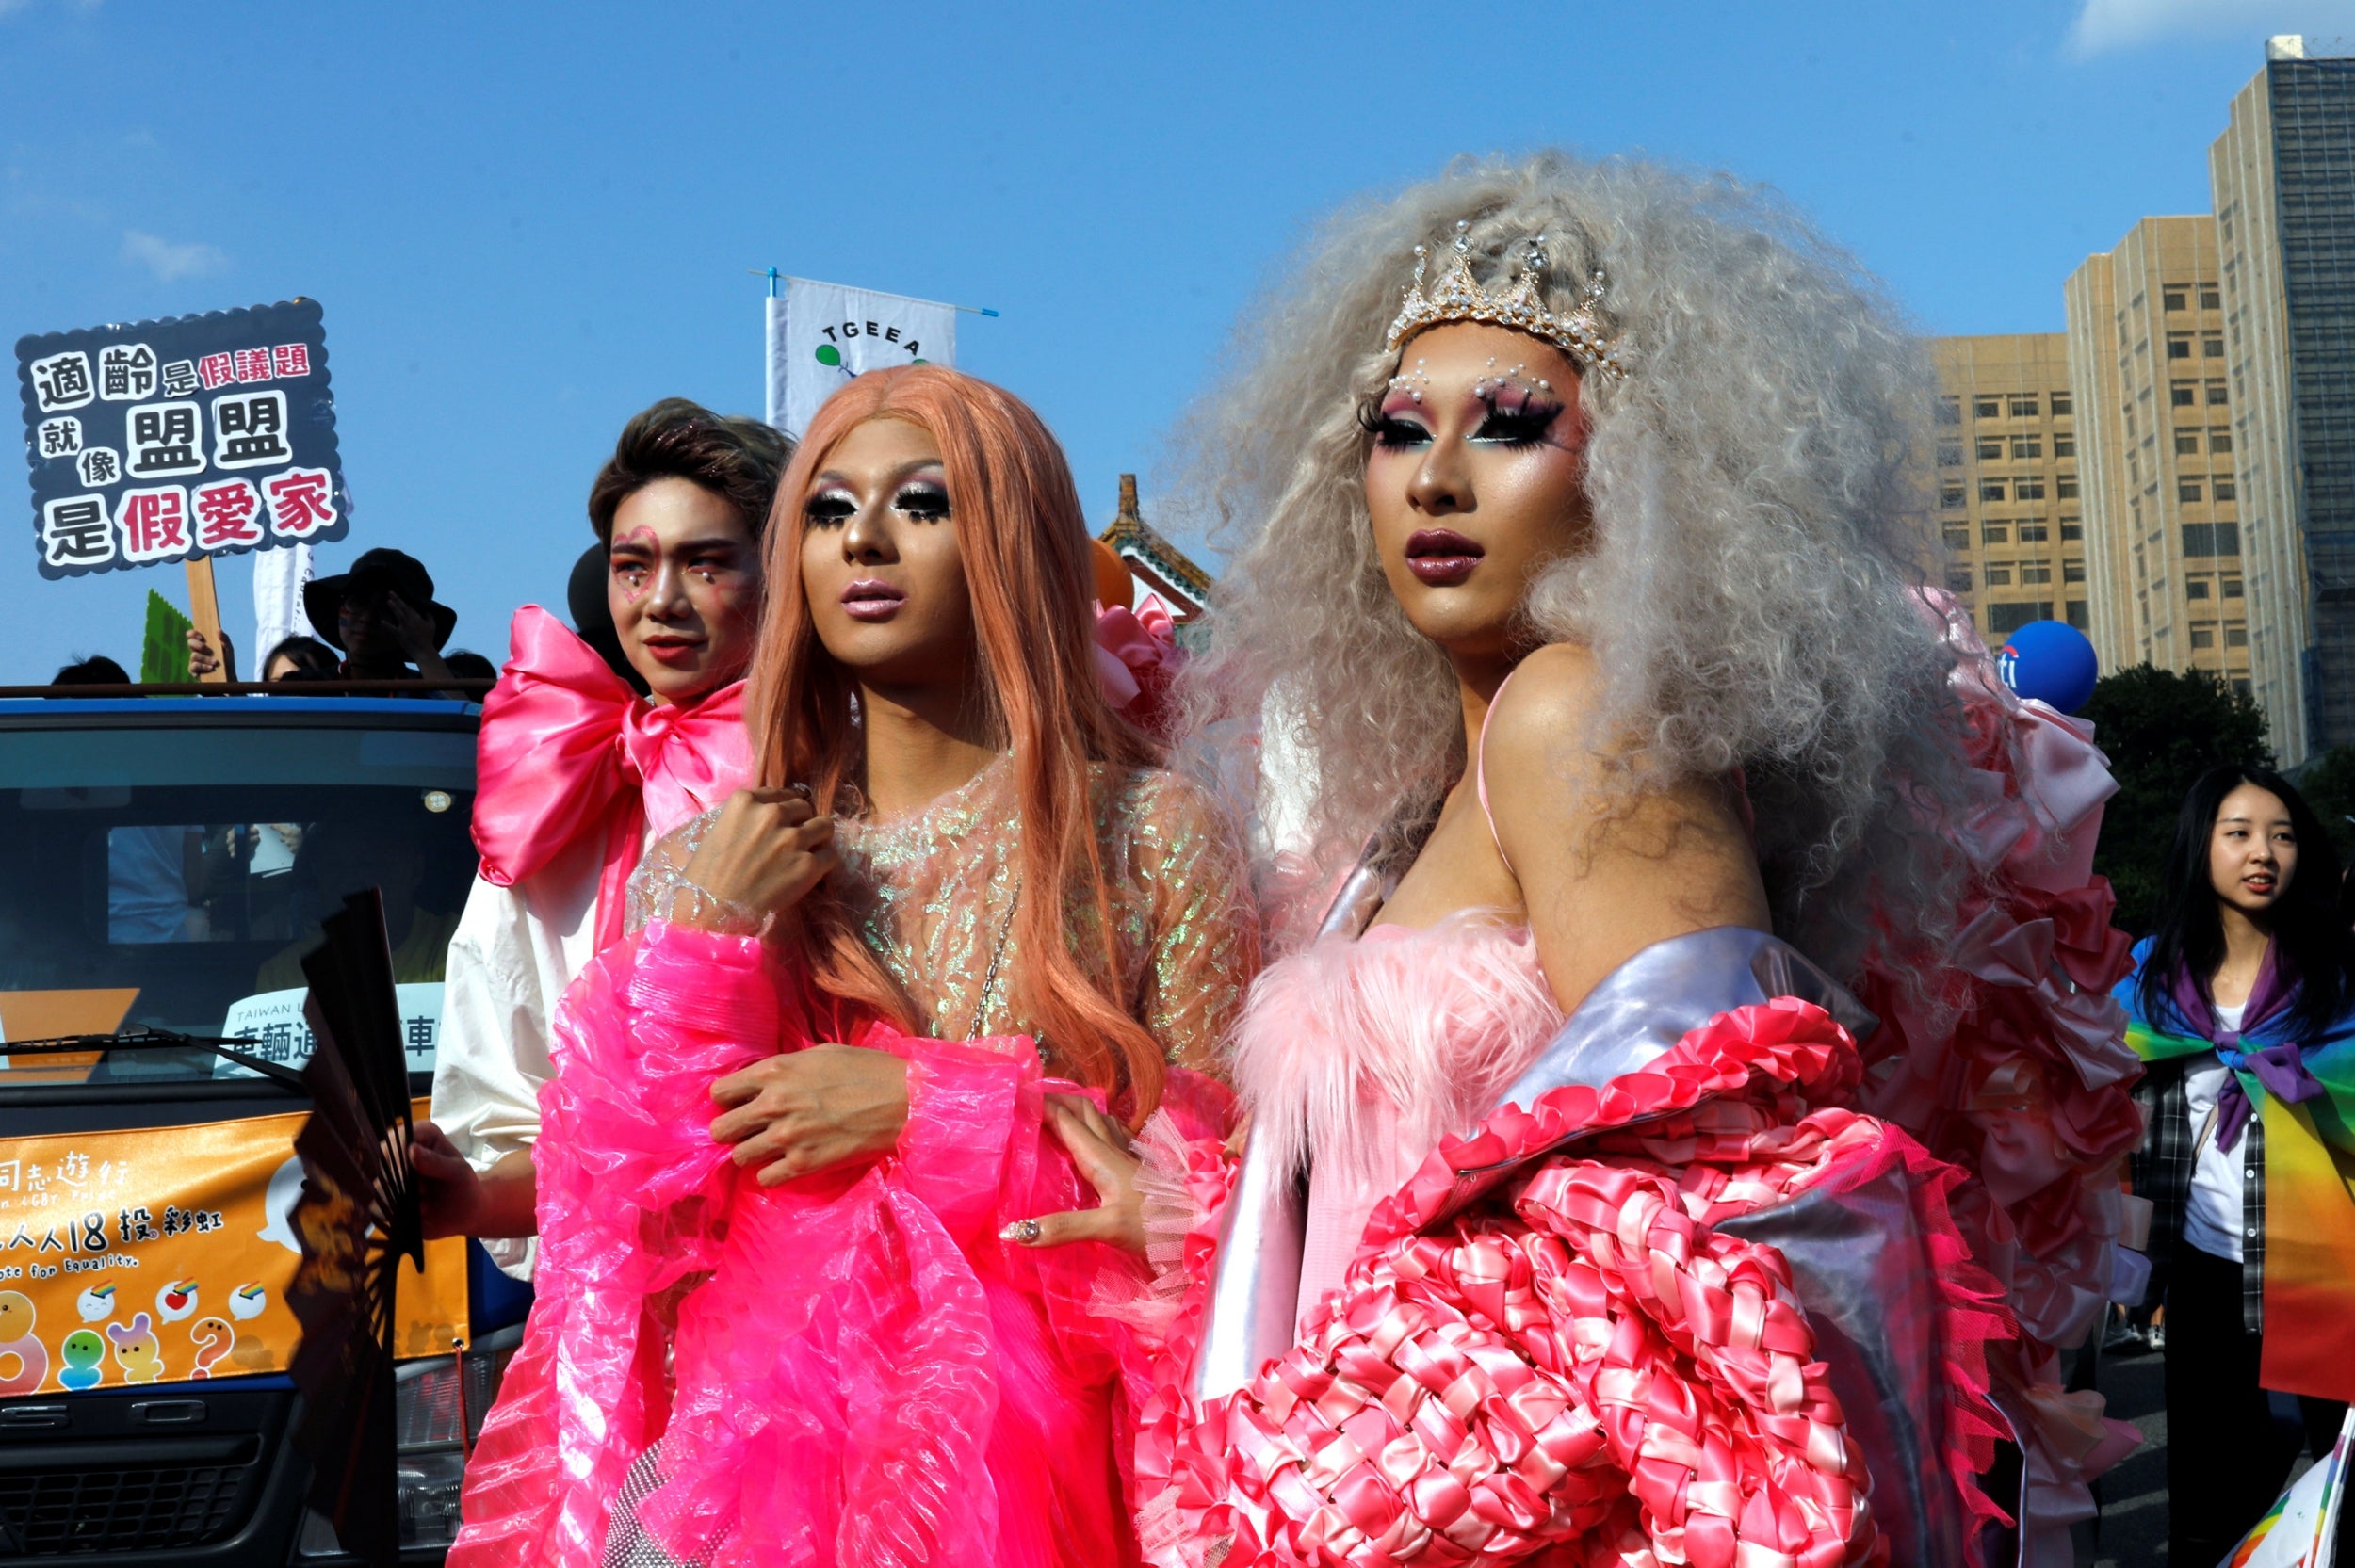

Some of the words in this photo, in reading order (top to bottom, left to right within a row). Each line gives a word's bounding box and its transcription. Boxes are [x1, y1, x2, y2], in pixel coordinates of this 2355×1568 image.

[822, 320, 919, 356] TGEEA
[32, 344, 310, 407] 適齡是假議題
[43, 396, 287, 482] 就像盟盟
[49, 473, 333, 561] 是假愛家
[237, 1004, 291, 1022] TAIWAN
[0, 1150, 129, 1191] 同志遊行
[22, 1193, 58, 1207] LGBT
[31, 1264, 56, 1279] for
[66, 1254, 138, 1271] Equality.
